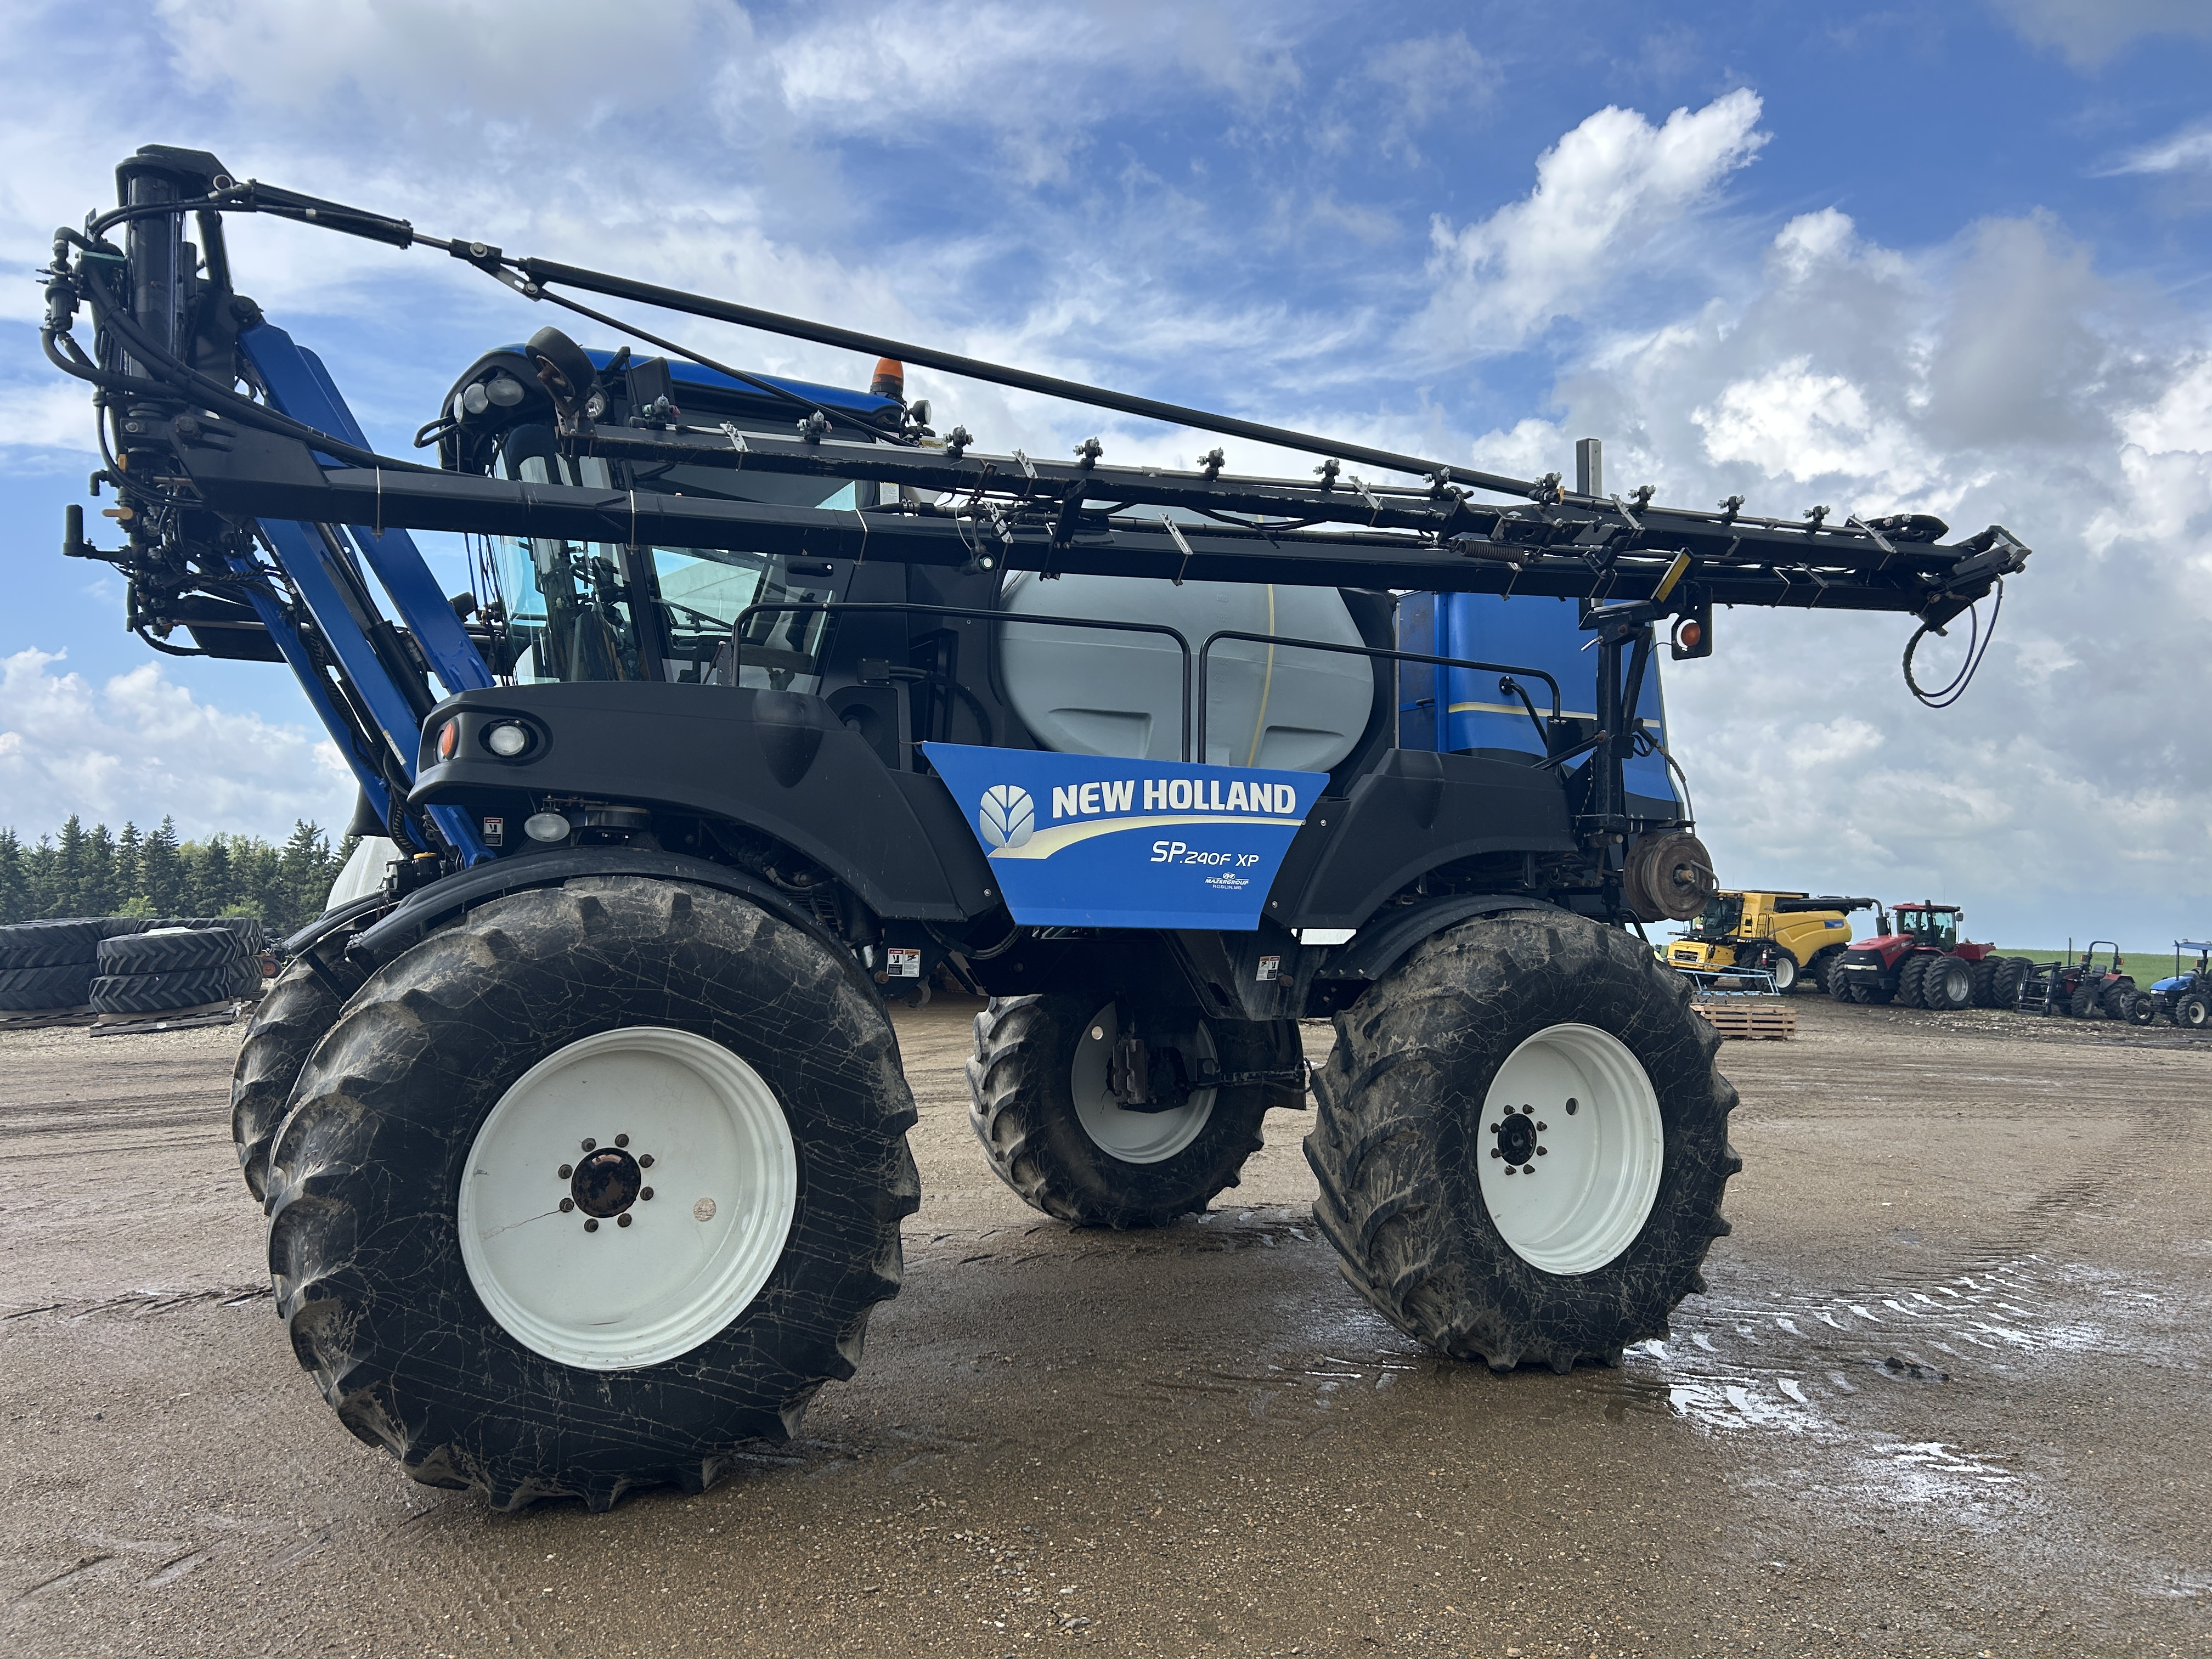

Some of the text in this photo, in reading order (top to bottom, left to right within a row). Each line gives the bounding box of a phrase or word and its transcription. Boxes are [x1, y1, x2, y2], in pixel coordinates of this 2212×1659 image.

[1217, 614, 1228, 623] 700
[1052, 779, 1296, 819] NEW HOLLAND
[1235, 854, 1259, 867] XP
